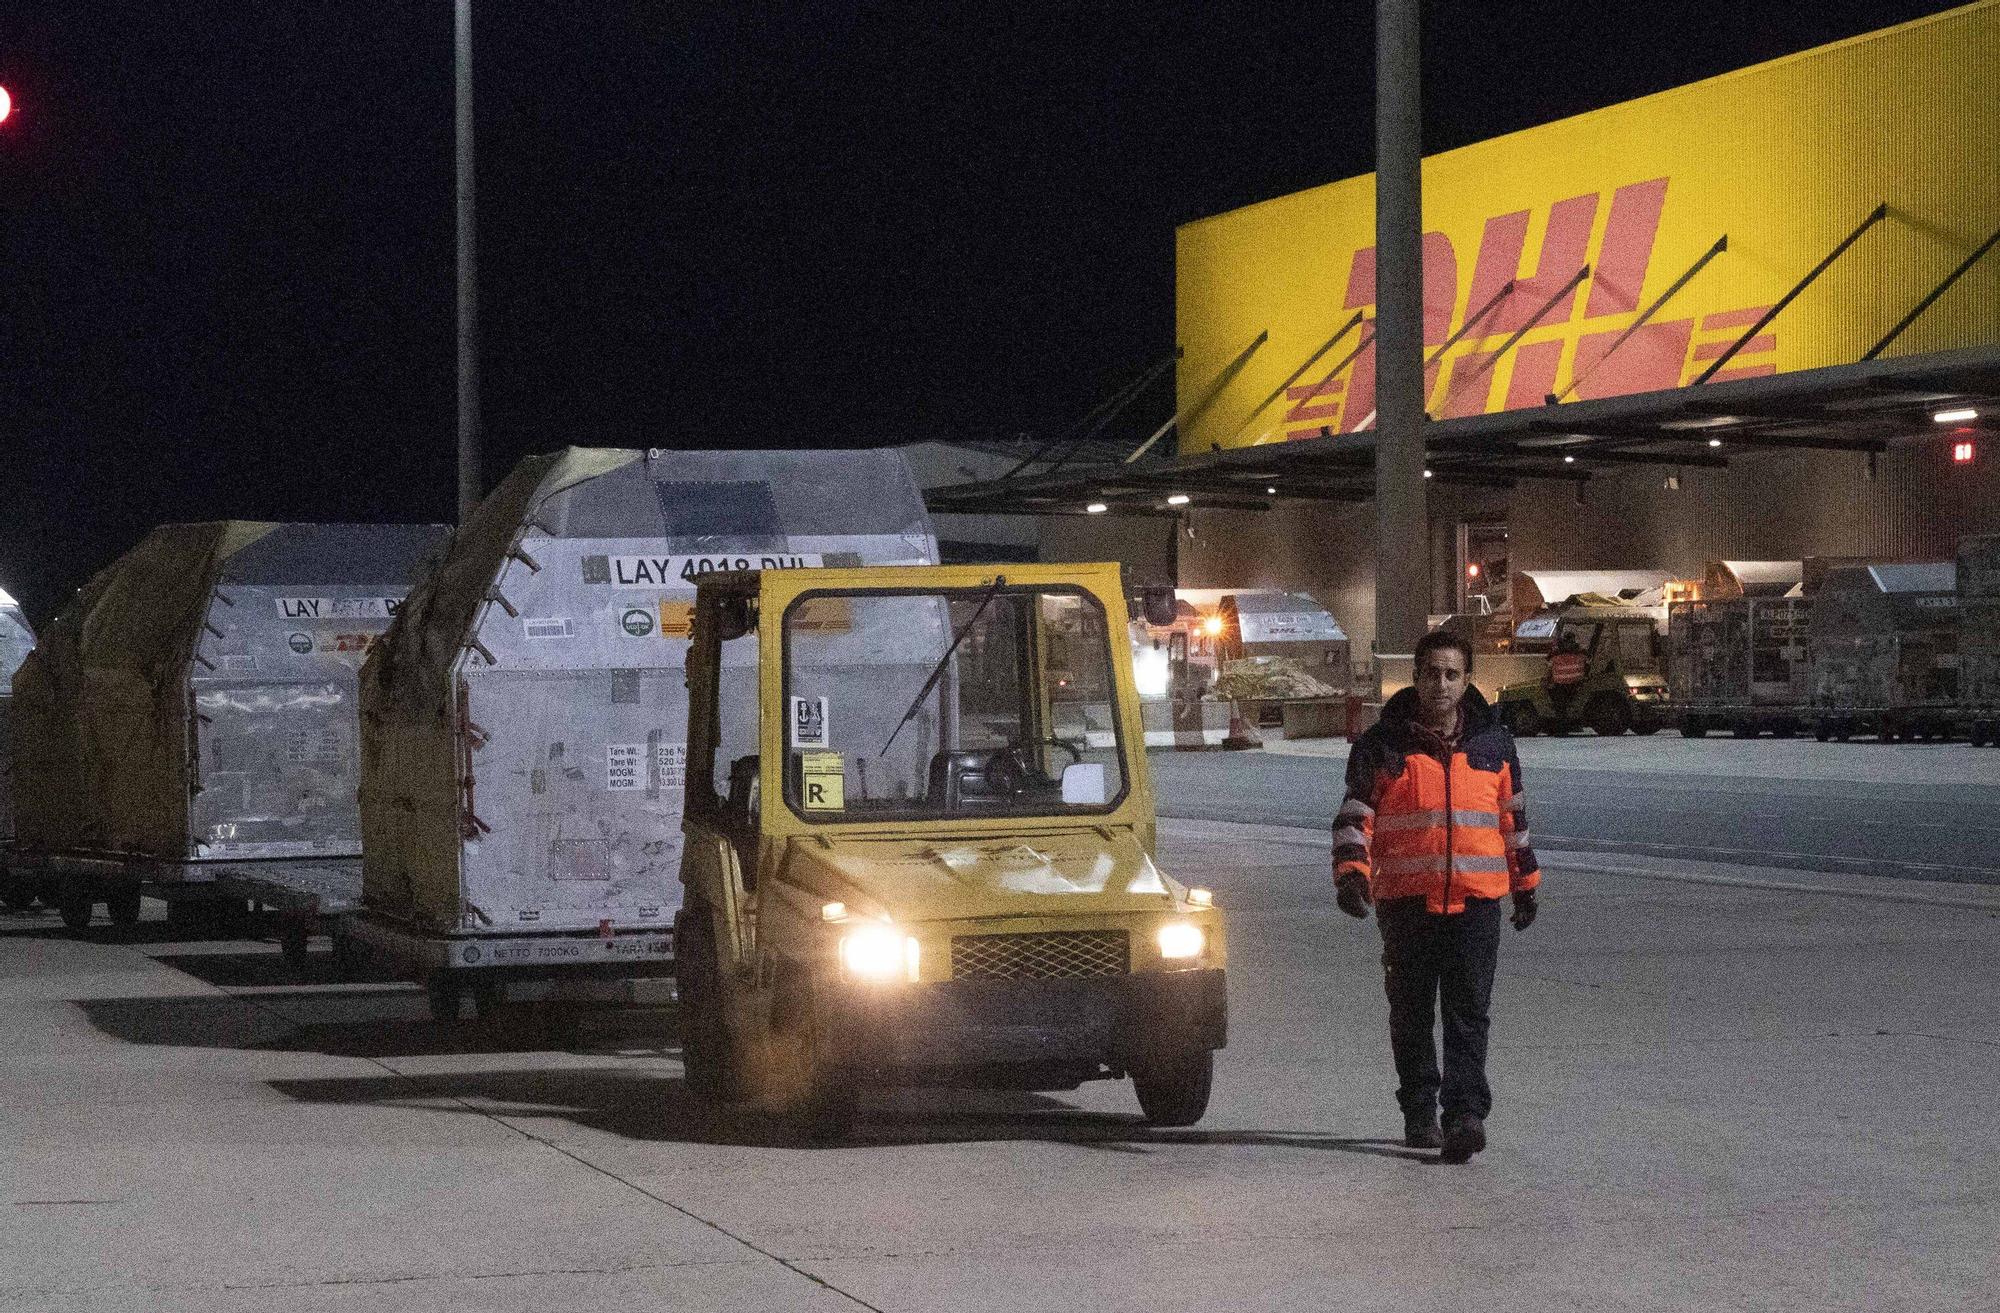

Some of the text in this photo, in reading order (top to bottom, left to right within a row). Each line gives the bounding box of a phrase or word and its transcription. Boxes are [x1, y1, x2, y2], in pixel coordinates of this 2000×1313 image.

[1340, 177, 1696, 433] DHL
[616, 558, 669, 584] LAY
[283, 599, 320, 617] LAY
[609, 747, 625, 756] Tare
[659, 748, 675, 756] 236
[609, 758, 625, 767] Tare
[658, 757, 674, 766] 520
[808, 783, 825, 803] R
[494, 948, 531, 958] NETTO
